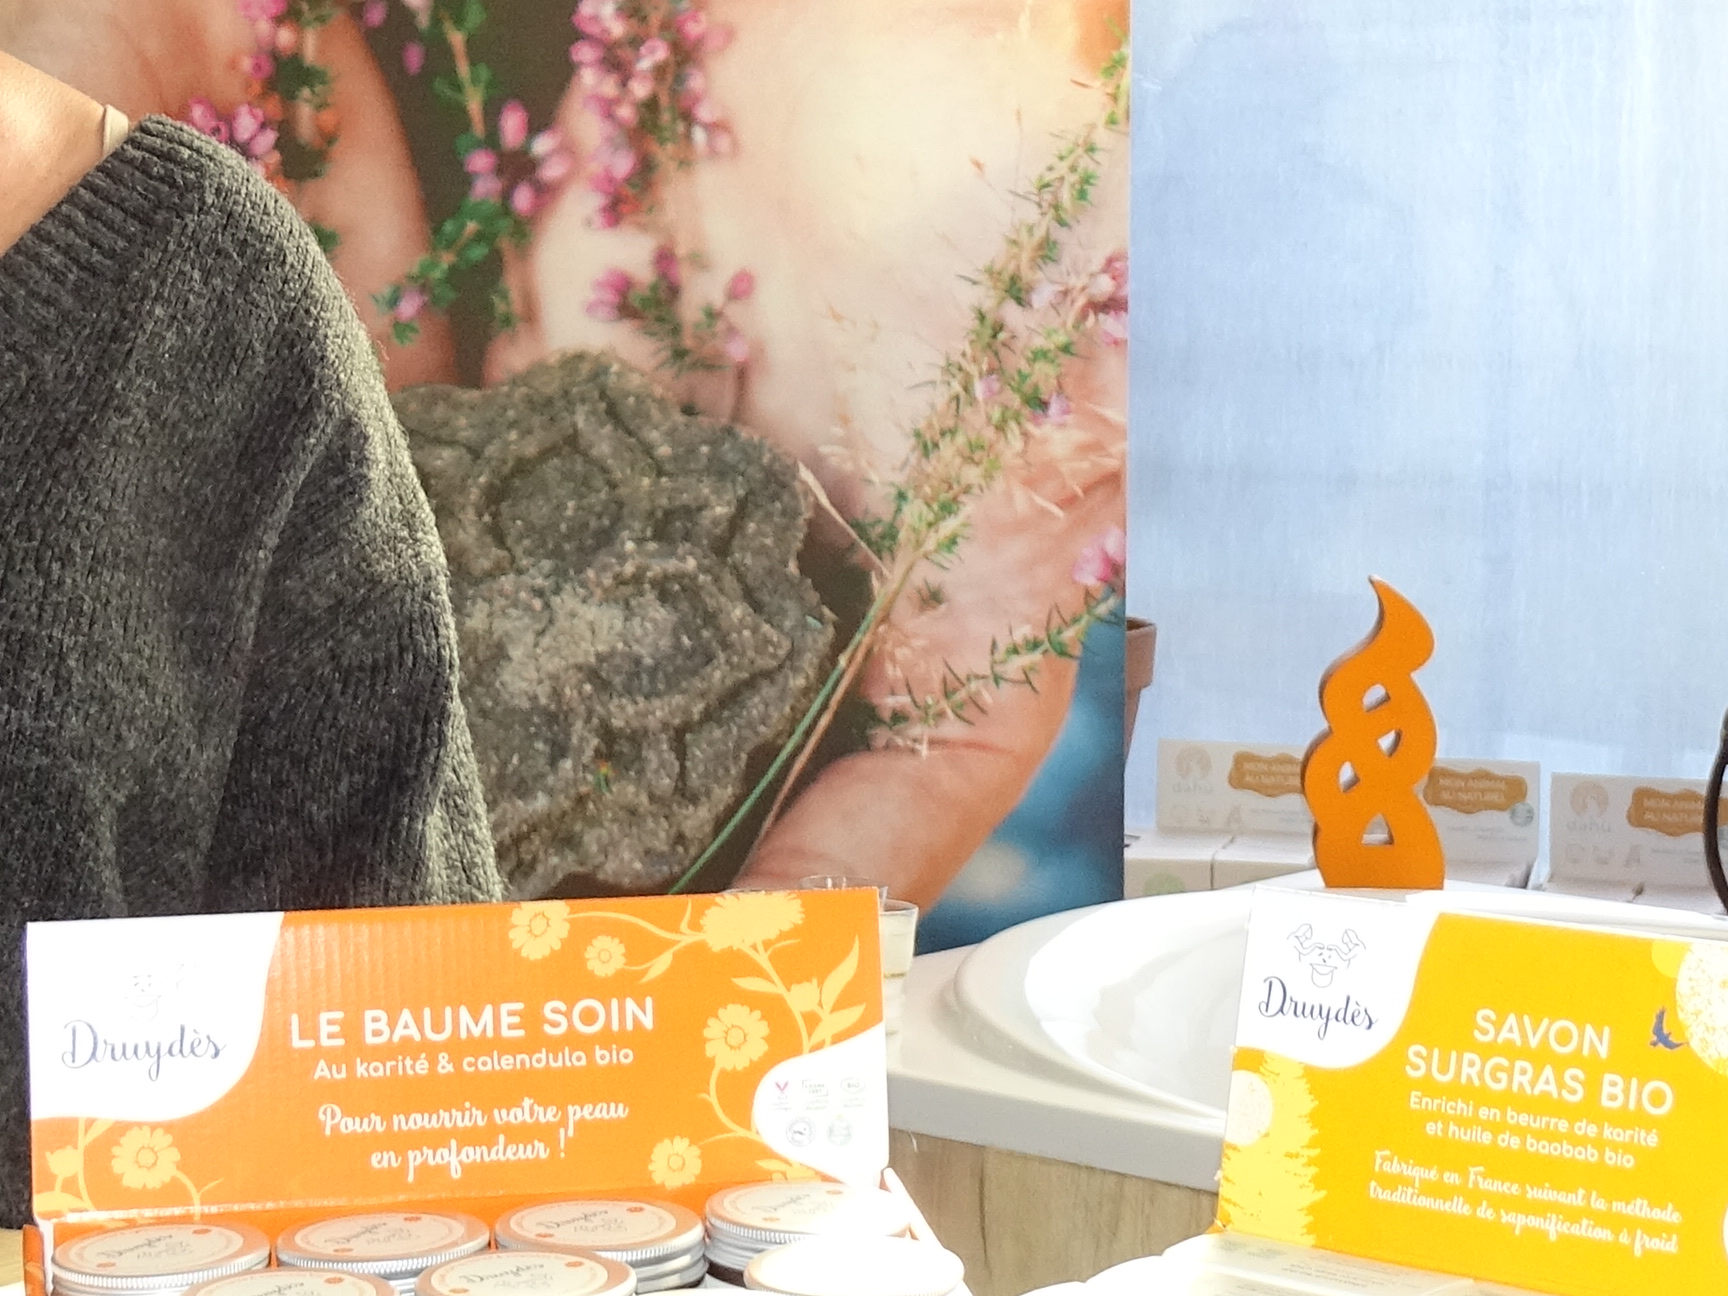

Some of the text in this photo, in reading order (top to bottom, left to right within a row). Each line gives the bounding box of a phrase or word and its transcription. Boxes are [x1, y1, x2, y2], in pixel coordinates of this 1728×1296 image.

[290, 996, 654, 1049] LE BAUME SOIN
[1258, 975, 1378, 1041] Druydès
[1473, 1008, 1612, 1059] SAVON
[61, 1019, 227, 1082] Druydès
[313, 1043, 634, 1081] Au karité & calendula bio
[1404, 1044, 1675, 1115] SURGRAS BIO
[318, 1096, 629, 1138] Pour nourrir votre peau
[1409, 1091, 1659, 1148] Enrichi en beurre de karité
[371, 1150, 401, 1169] en
[408, 1134, 550, 1183] profondeur
[1425, 1121, 1635, 1169] et huile de baobab bio
[1374, 1149, 1682, 1224] Fabriqué en France suivant la méthode
[1369, 1179, 1679, 1257] traditionnelle de saponification à froid
